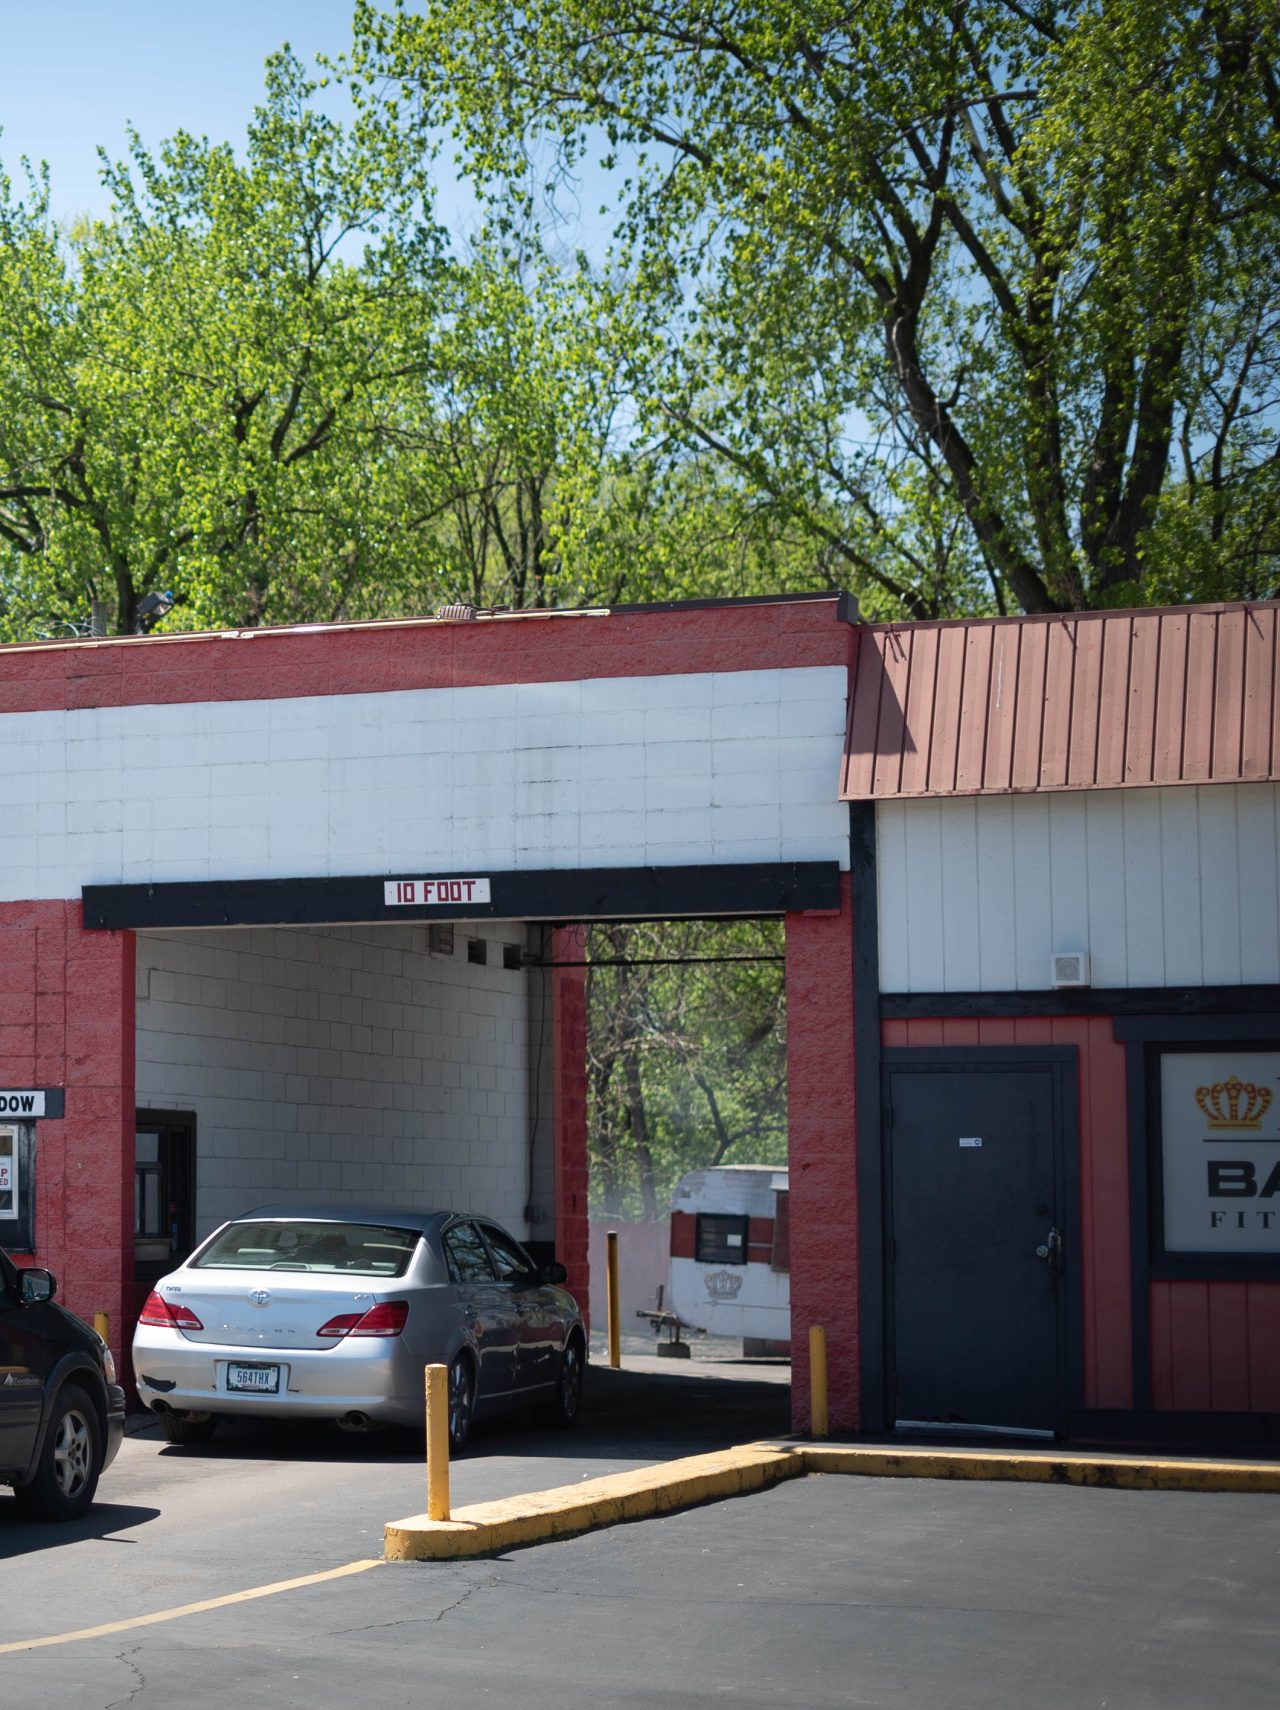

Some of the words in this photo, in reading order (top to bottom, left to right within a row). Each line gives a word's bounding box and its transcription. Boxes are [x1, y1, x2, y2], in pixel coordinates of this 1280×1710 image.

[397, 883, 415, 903] 10
[424, 881, 476, 902] FOOT
[1209, 1211, 1276, 1229] FIT
[236, 1370, 271, 1386] 564THX
